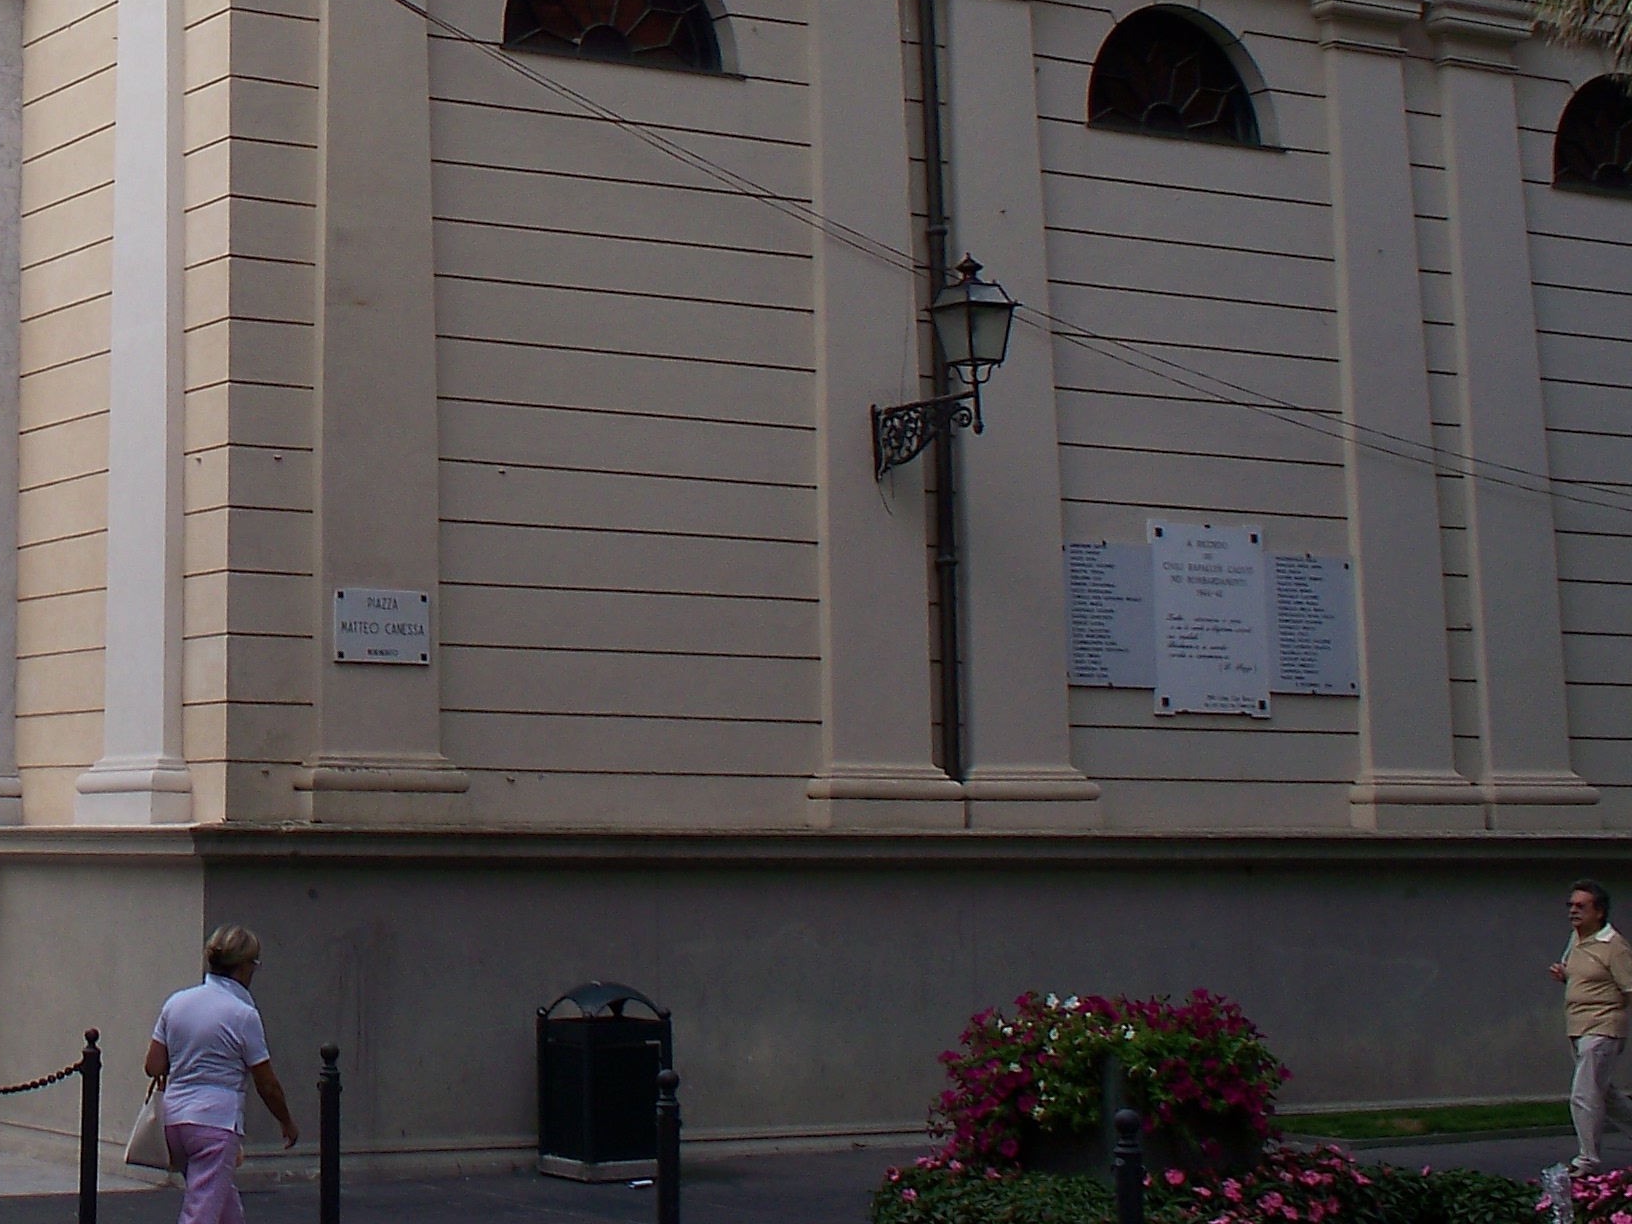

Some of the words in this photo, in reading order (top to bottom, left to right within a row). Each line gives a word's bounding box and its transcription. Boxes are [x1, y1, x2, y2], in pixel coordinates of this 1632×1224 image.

[367, 596, 399, 610] PIAZZA
[341, 620, 379, 635] MATTEO
[385, 622, 425, 636] CANESSA
